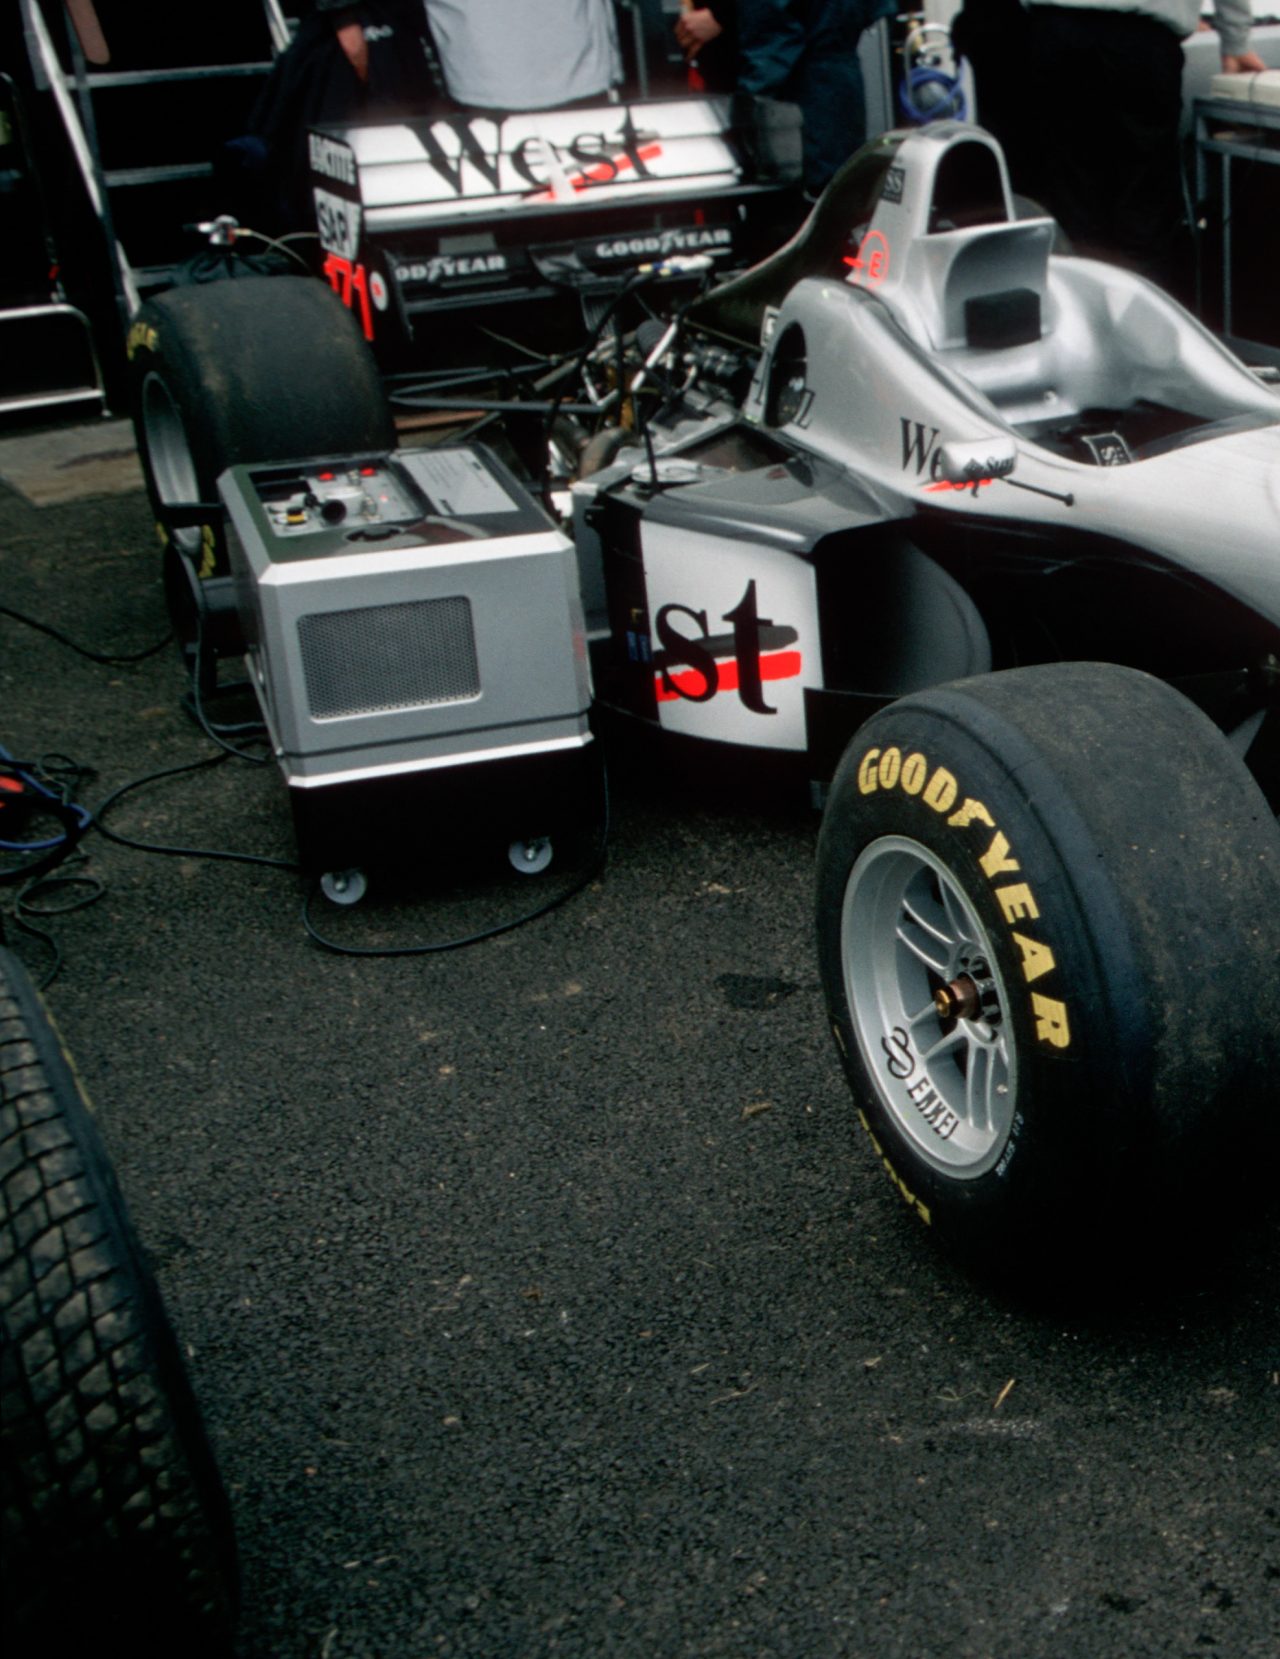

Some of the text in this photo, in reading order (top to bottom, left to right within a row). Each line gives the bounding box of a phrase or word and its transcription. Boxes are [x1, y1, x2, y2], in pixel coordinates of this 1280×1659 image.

[404, 103, 657, 196] West
[395, 255, 506, 283] ODYEAR
[650, 579, 780, 715] st
